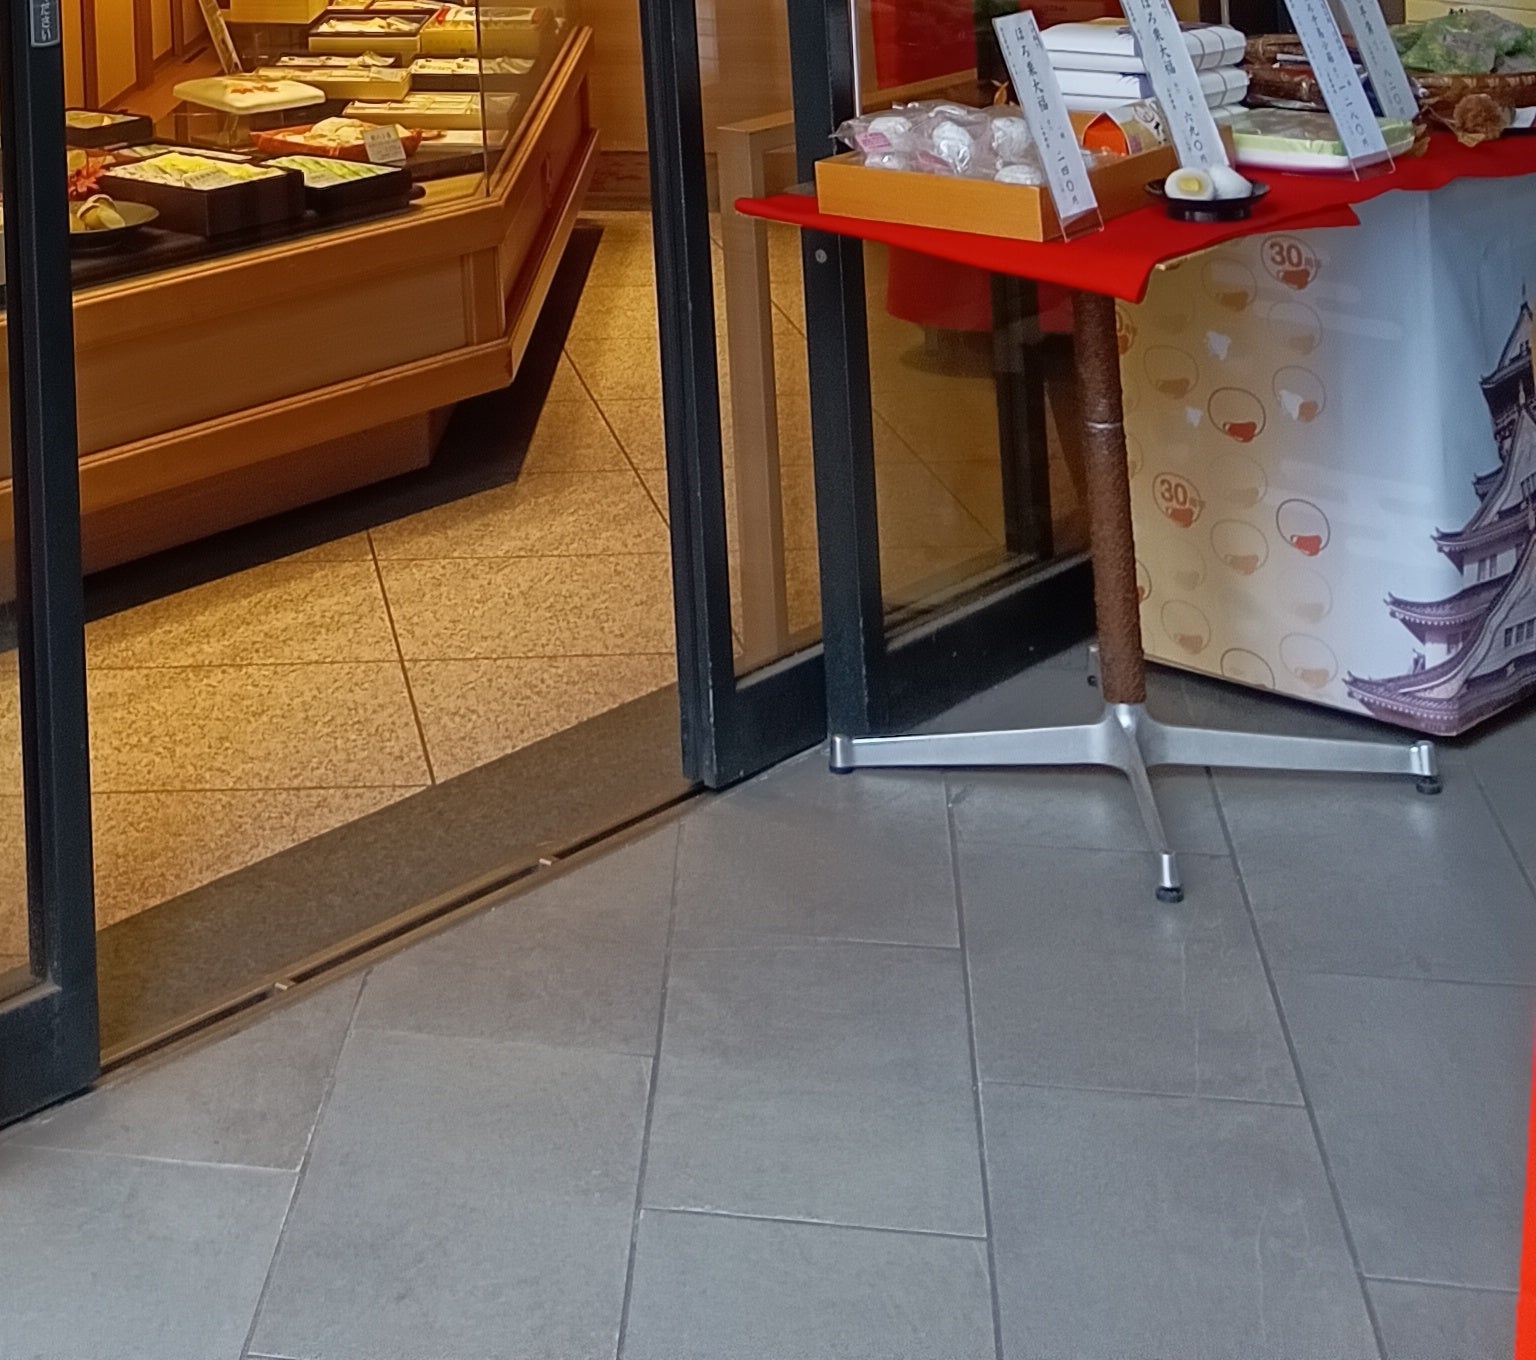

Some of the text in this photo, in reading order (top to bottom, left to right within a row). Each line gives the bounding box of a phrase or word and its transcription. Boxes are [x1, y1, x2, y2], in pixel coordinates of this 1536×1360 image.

[1012, 25, 1050, 112] ほろ栗大福
